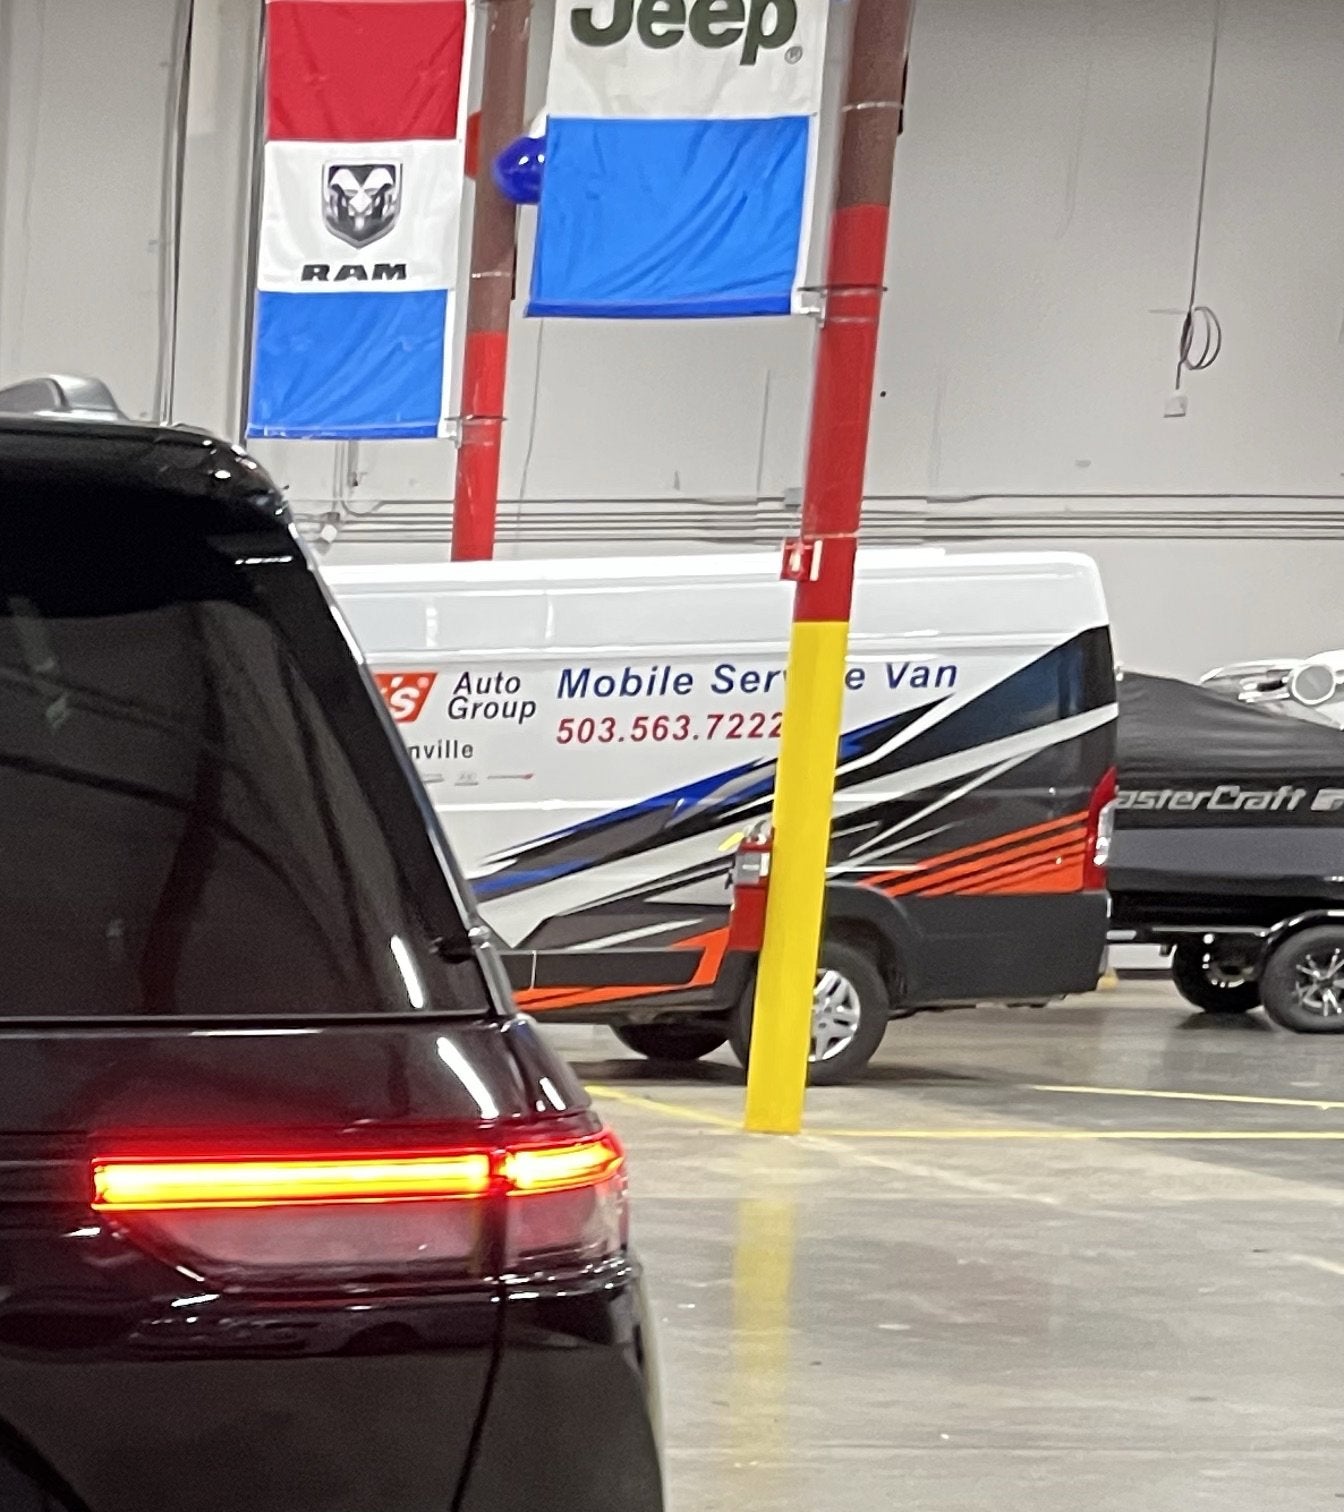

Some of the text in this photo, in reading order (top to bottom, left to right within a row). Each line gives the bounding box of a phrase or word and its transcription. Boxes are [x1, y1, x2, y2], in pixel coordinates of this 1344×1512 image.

[570, 0, 797, 66] Jeep
[300, 263, 407, 281] RAM
[453, 671, 521, 695] Auto
[556, 662, 958, 699] Mobile Sere Van
[448, 696, 537, 725] Group
[556, 711, 783, 744] 503.563.7222
[1113, 785, 1307, 811] asterCraft
